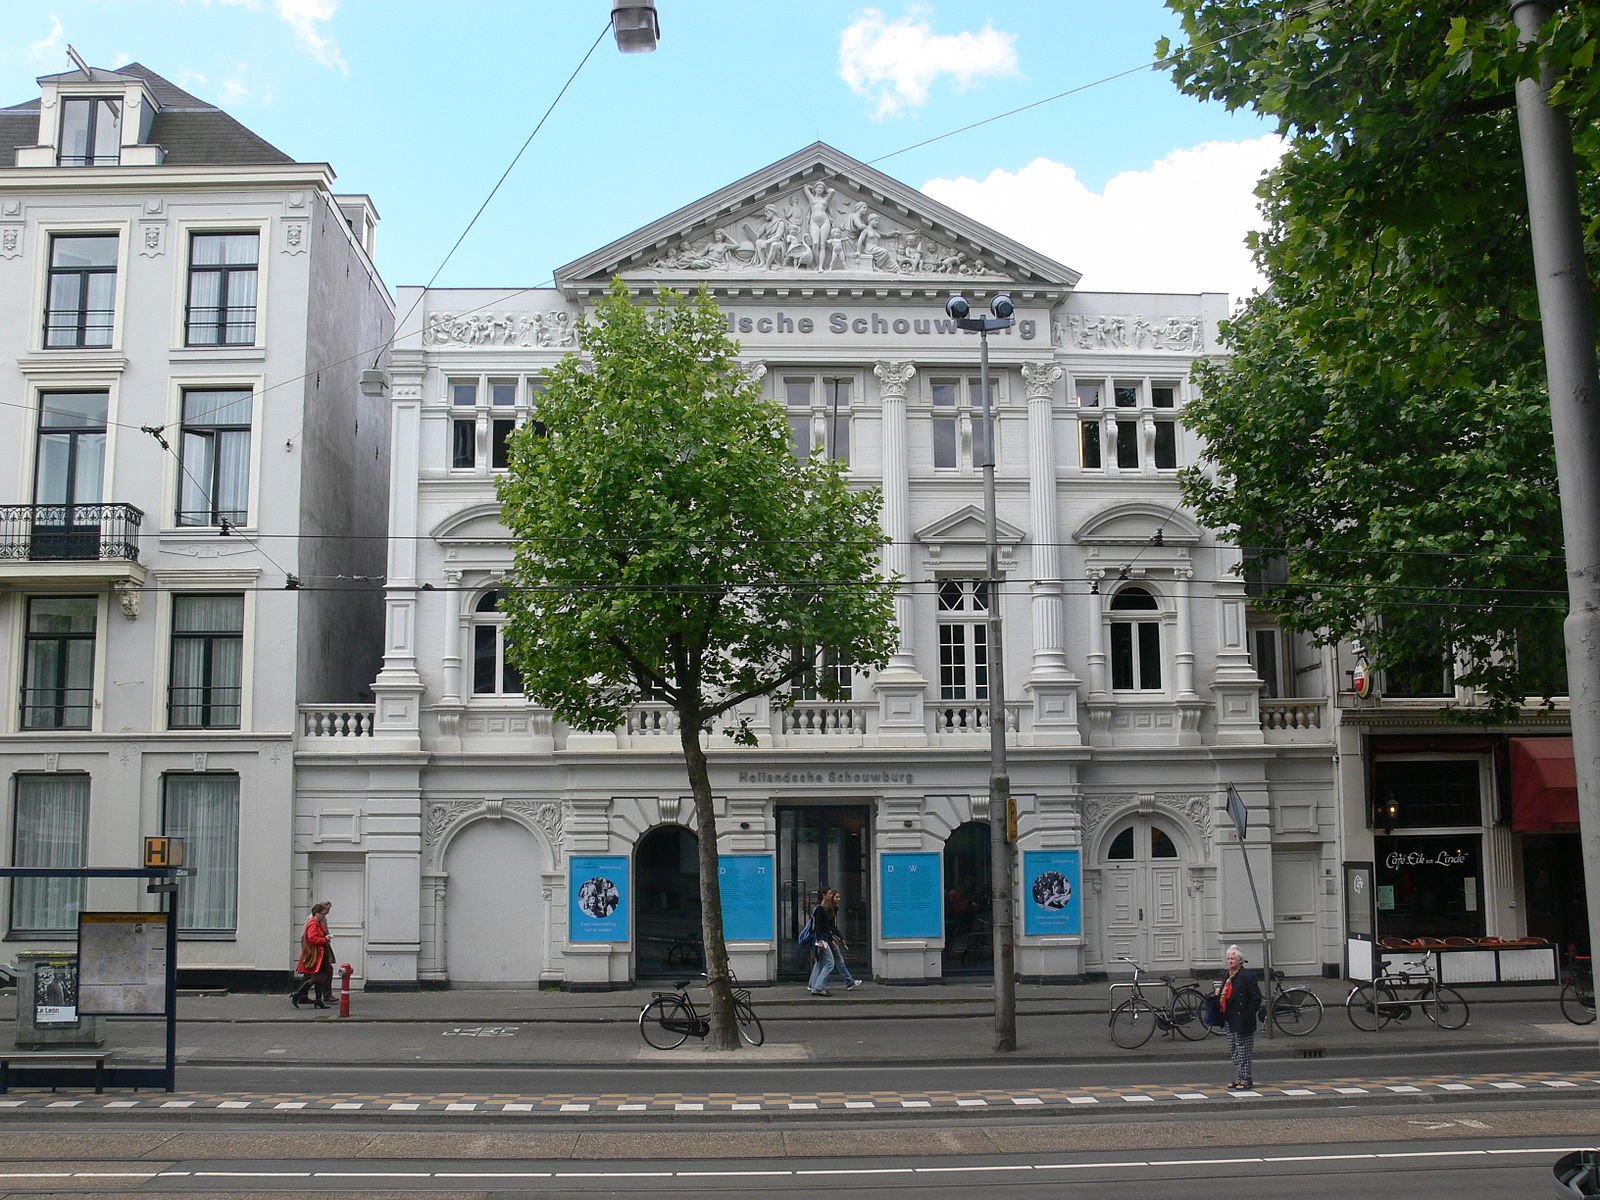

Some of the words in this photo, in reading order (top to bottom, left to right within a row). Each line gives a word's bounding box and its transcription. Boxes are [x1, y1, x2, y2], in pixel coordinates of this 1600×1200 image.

[828, 312, 1036, 340] Schouwg
[738, 771, 823, 784] Hollandsche
[827, 771, 913, 785] Schouwburg
[147, 841, 166, 863] H
[1386, 852, 1406, 871] Café
[1406, 852, 1426, 865] Eik
[1435, 851, 1467, 867] Linde
